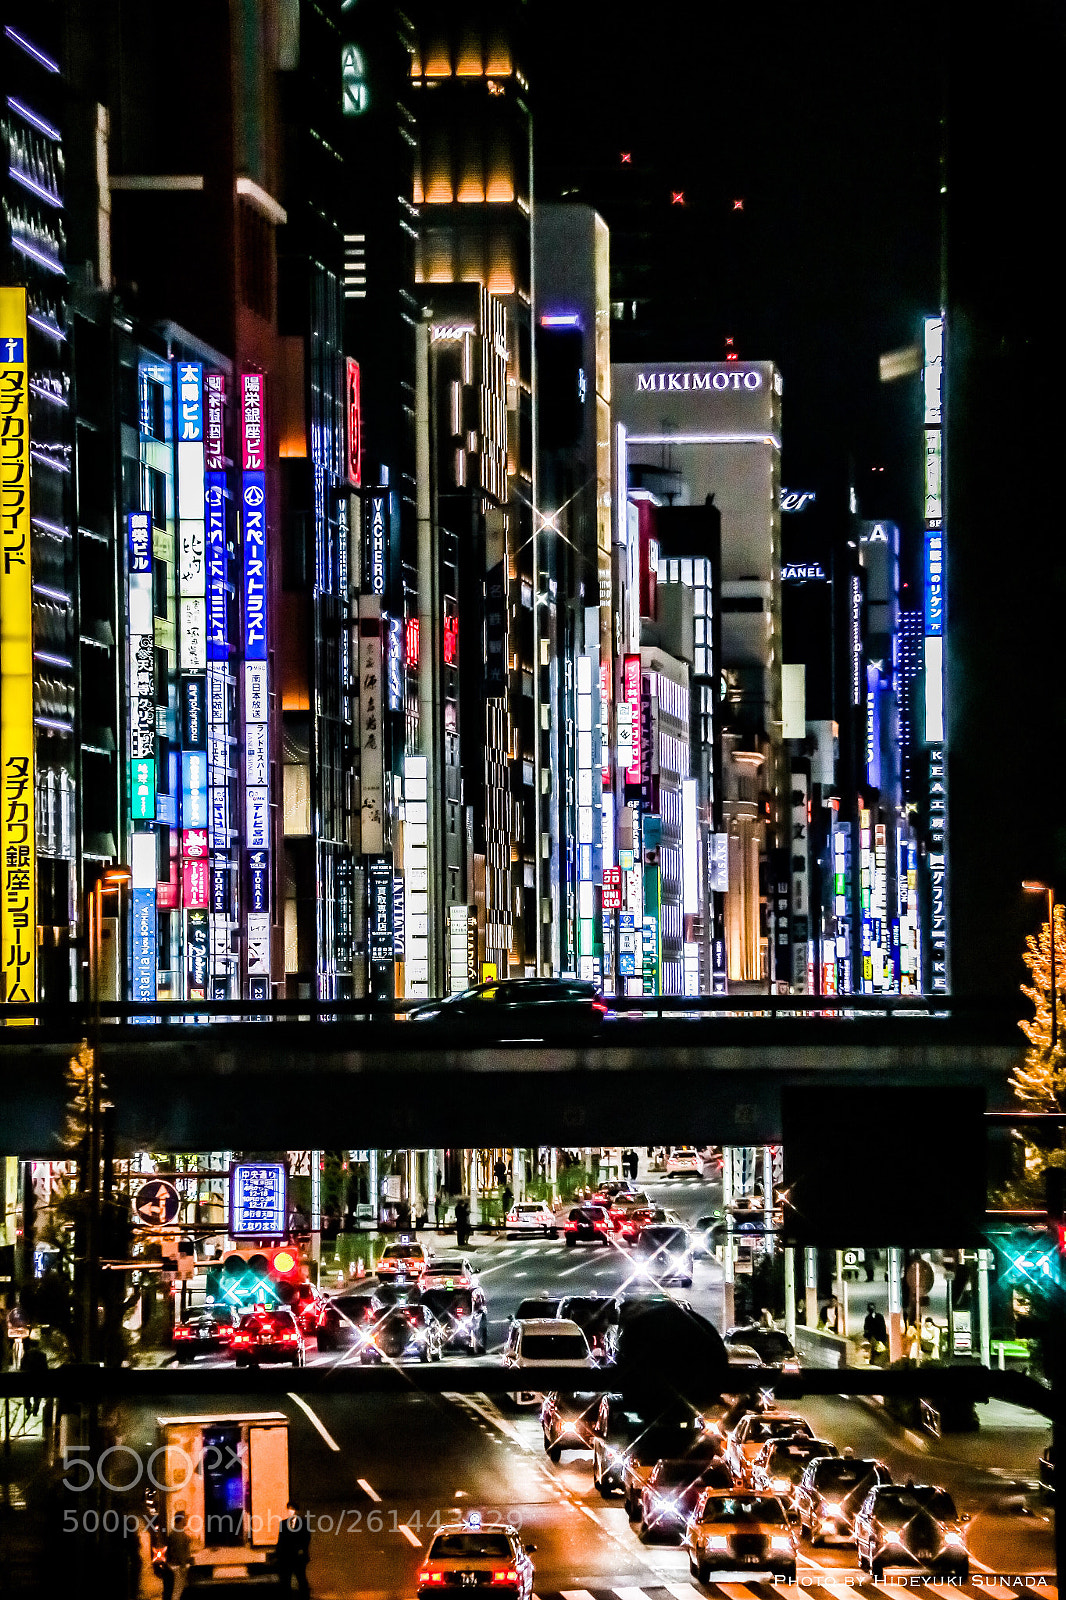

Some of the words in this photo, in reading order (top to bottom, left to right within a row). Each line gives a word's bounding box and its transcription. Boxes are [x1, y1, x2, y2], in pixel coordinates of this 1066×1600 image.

[636, 372, 763, 391] MIKIMOTO
[245, 377, 260, 468] 陽栄銀座ビル
[0, 370, 26, 574] タチカワブラインド
[247, 511, 264, 645] スペーストラスト
[252, 675, 261, 718] 南日本放送
[6, 757, 30, 1002] タチカワ銀座ショールーム
[718, 840, 726, 885] TASAKI
[254, 870, 262, 909] TORAIZ
[604, 899, 620, 908] QLO
[141, 907, 149, 936] SOPHIA
[393, 877, 404, 954] DAMIANI
[242, 1171, 276, 1179] 中央通り
[239, 1222, 278, 1231] になります
[244, 1210, 274, 1218] 歩行者天国
